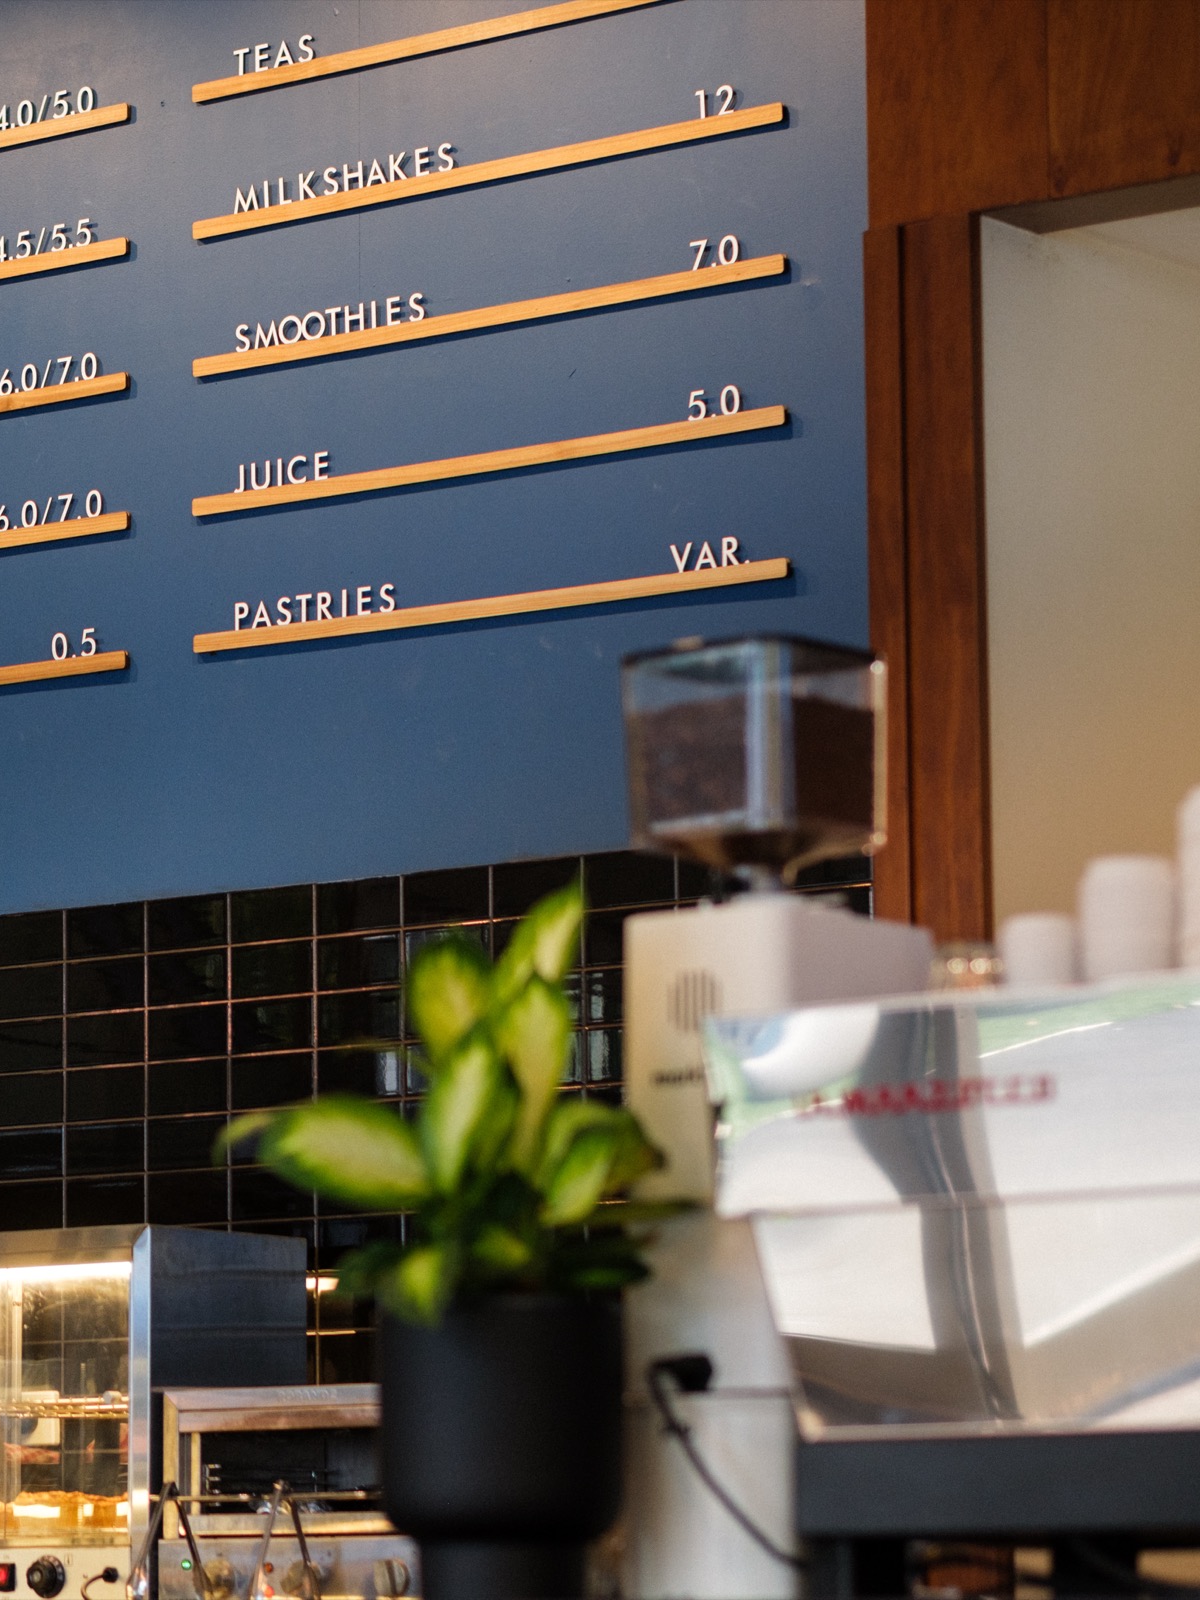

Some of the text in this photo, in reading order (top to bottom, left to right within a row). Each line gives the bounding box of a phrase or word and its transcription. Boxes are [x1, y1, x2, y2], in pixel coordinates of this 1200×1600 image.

[232, 34, 315, 77] TEAS
[694, 84, 736, 120] 12
[233, 142, 455, 215] MILKSHAKES
[688, 234, 740, 272] 7.0
[235, 292, 426, 353] SMOOTHIES
[687, 385, 741, 422] 5.0
[233, 451, 329, 494] JUICE
[669, 536, 751, 574] VAR.
[234, 583, 396, 631] PASTRIES
[51, 627, 97, 661] 0.5
